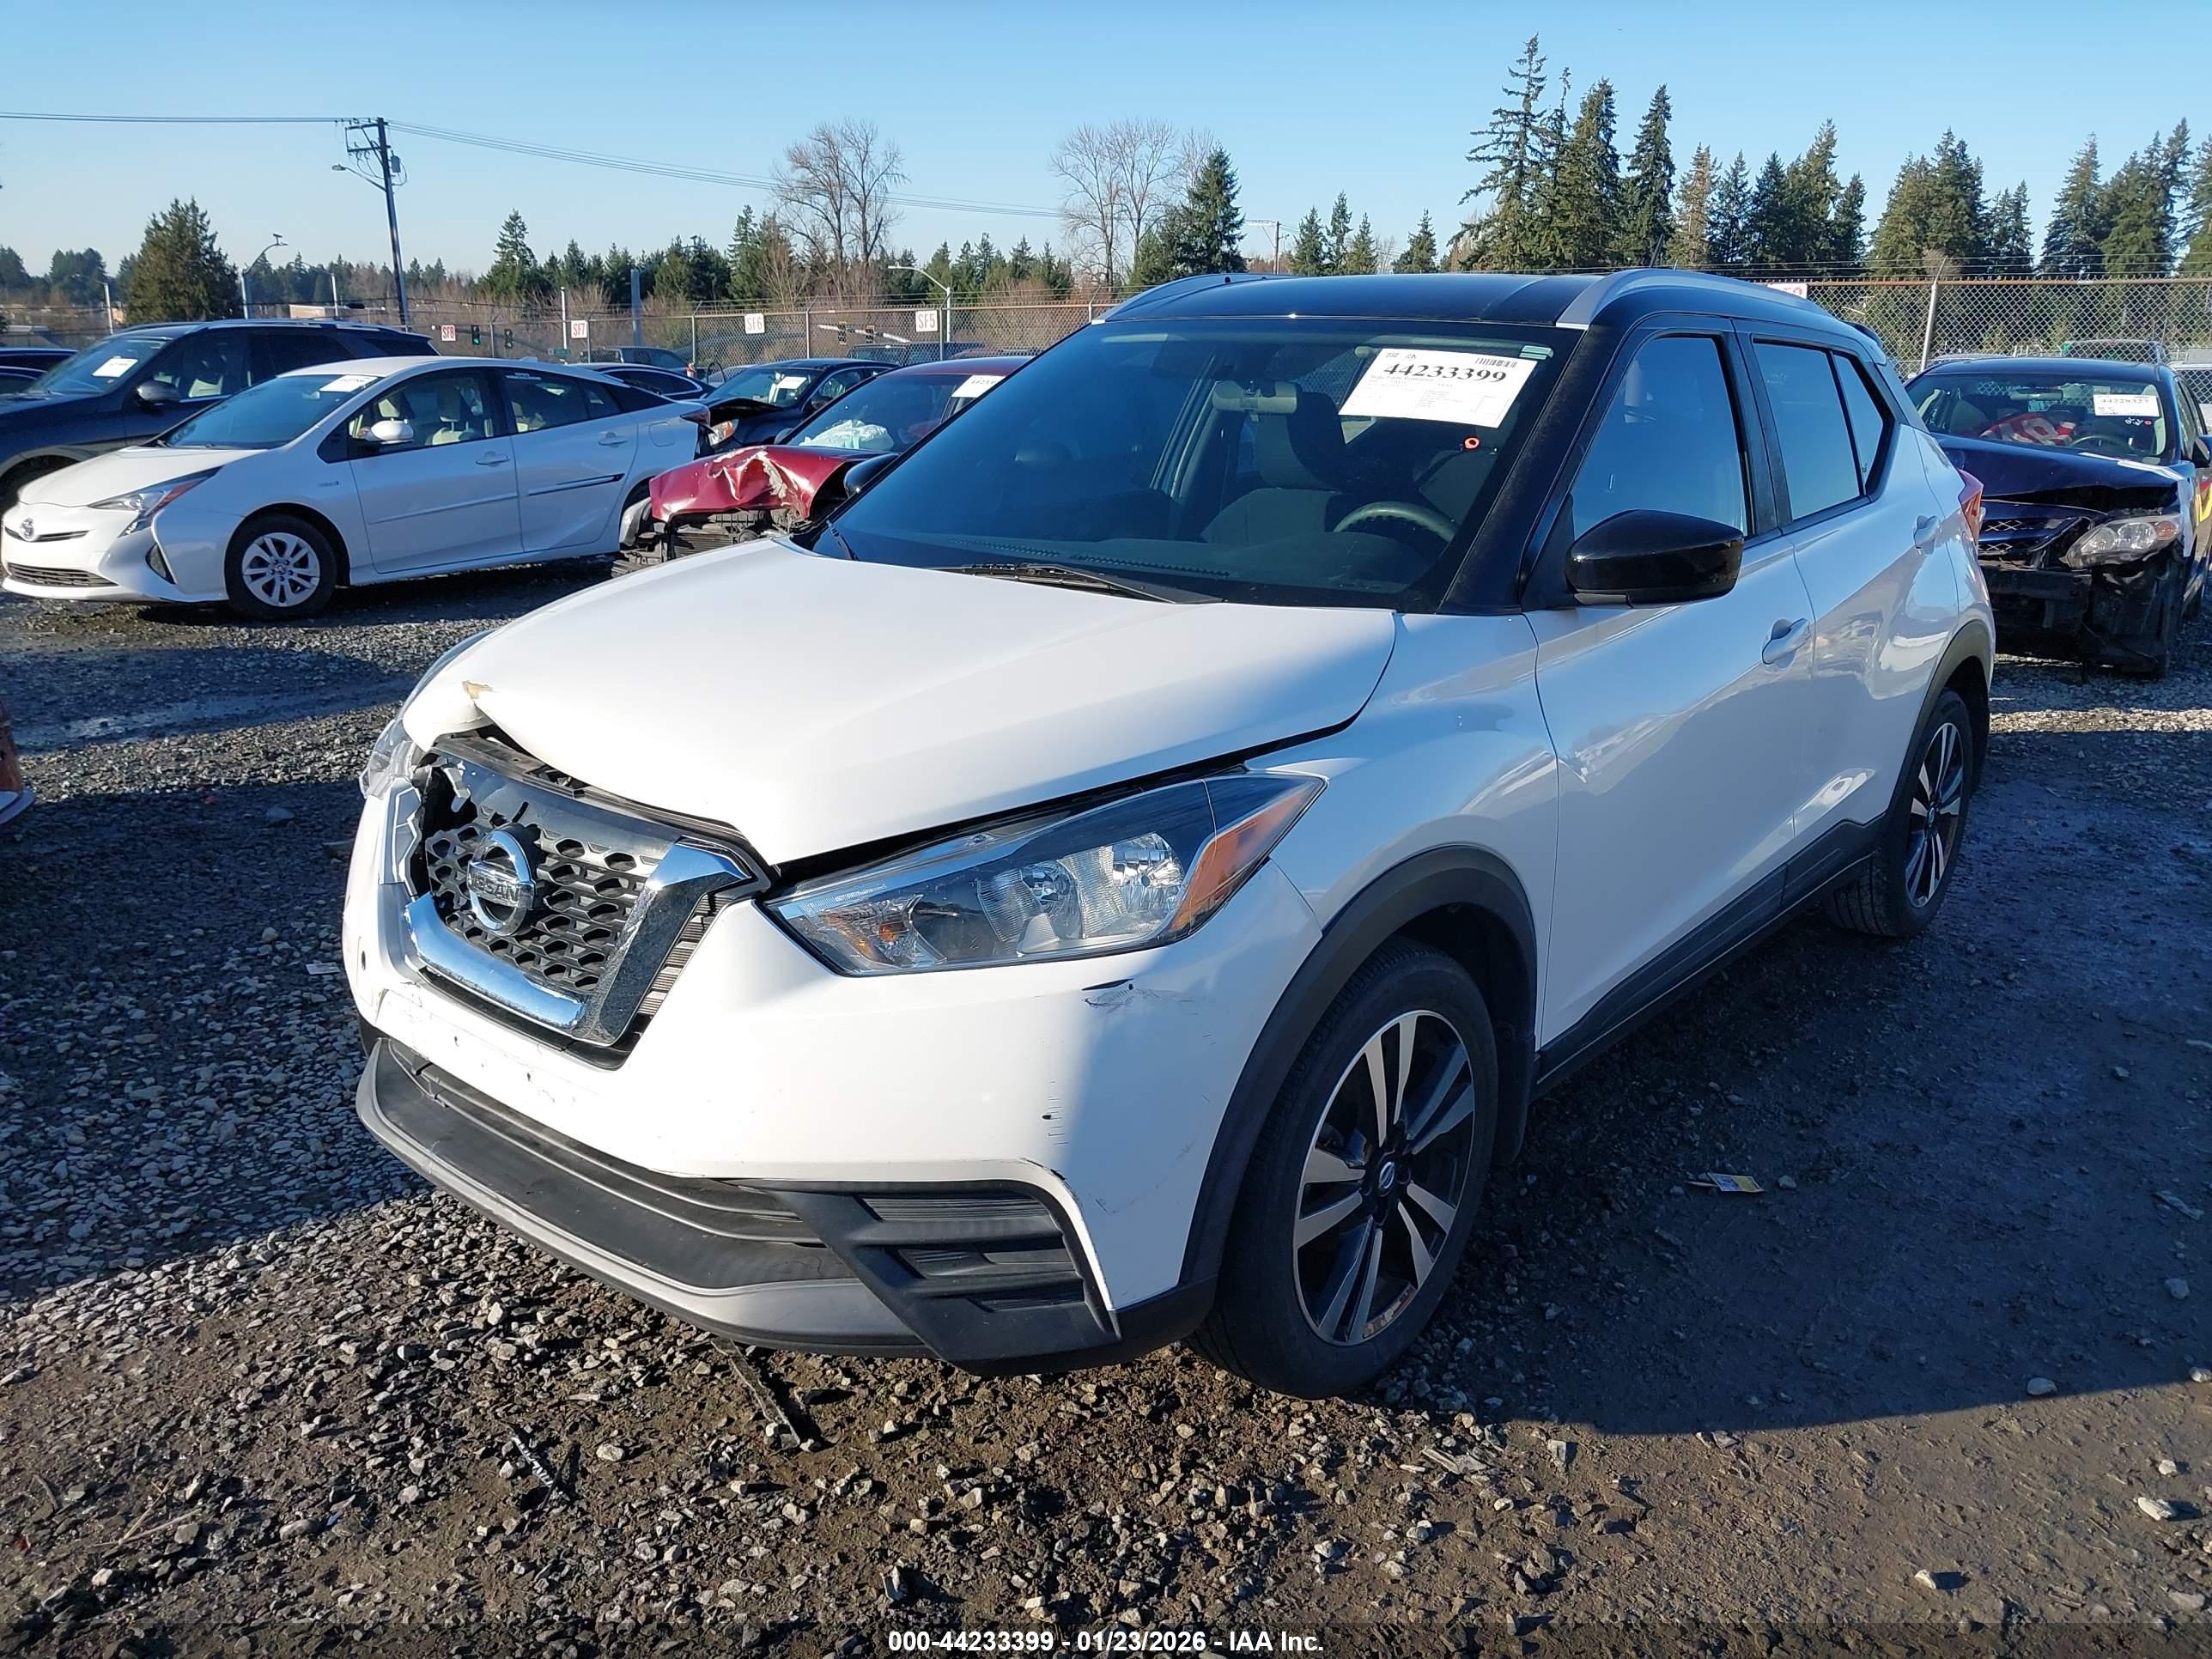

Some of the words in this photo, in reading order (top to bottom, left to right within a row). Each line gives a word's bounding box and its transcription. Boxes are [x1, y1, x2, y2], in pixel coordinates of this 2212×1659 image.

[746, 316, 763, 331] SF6
[918, 313, 935, 329] SF5
[442, 326, 454, 339] SF8
[573, 322, 586, 337] SF7
[1383, 363, 1507, 383] 44233399
[468, 872, 520, 902] NISSAN
